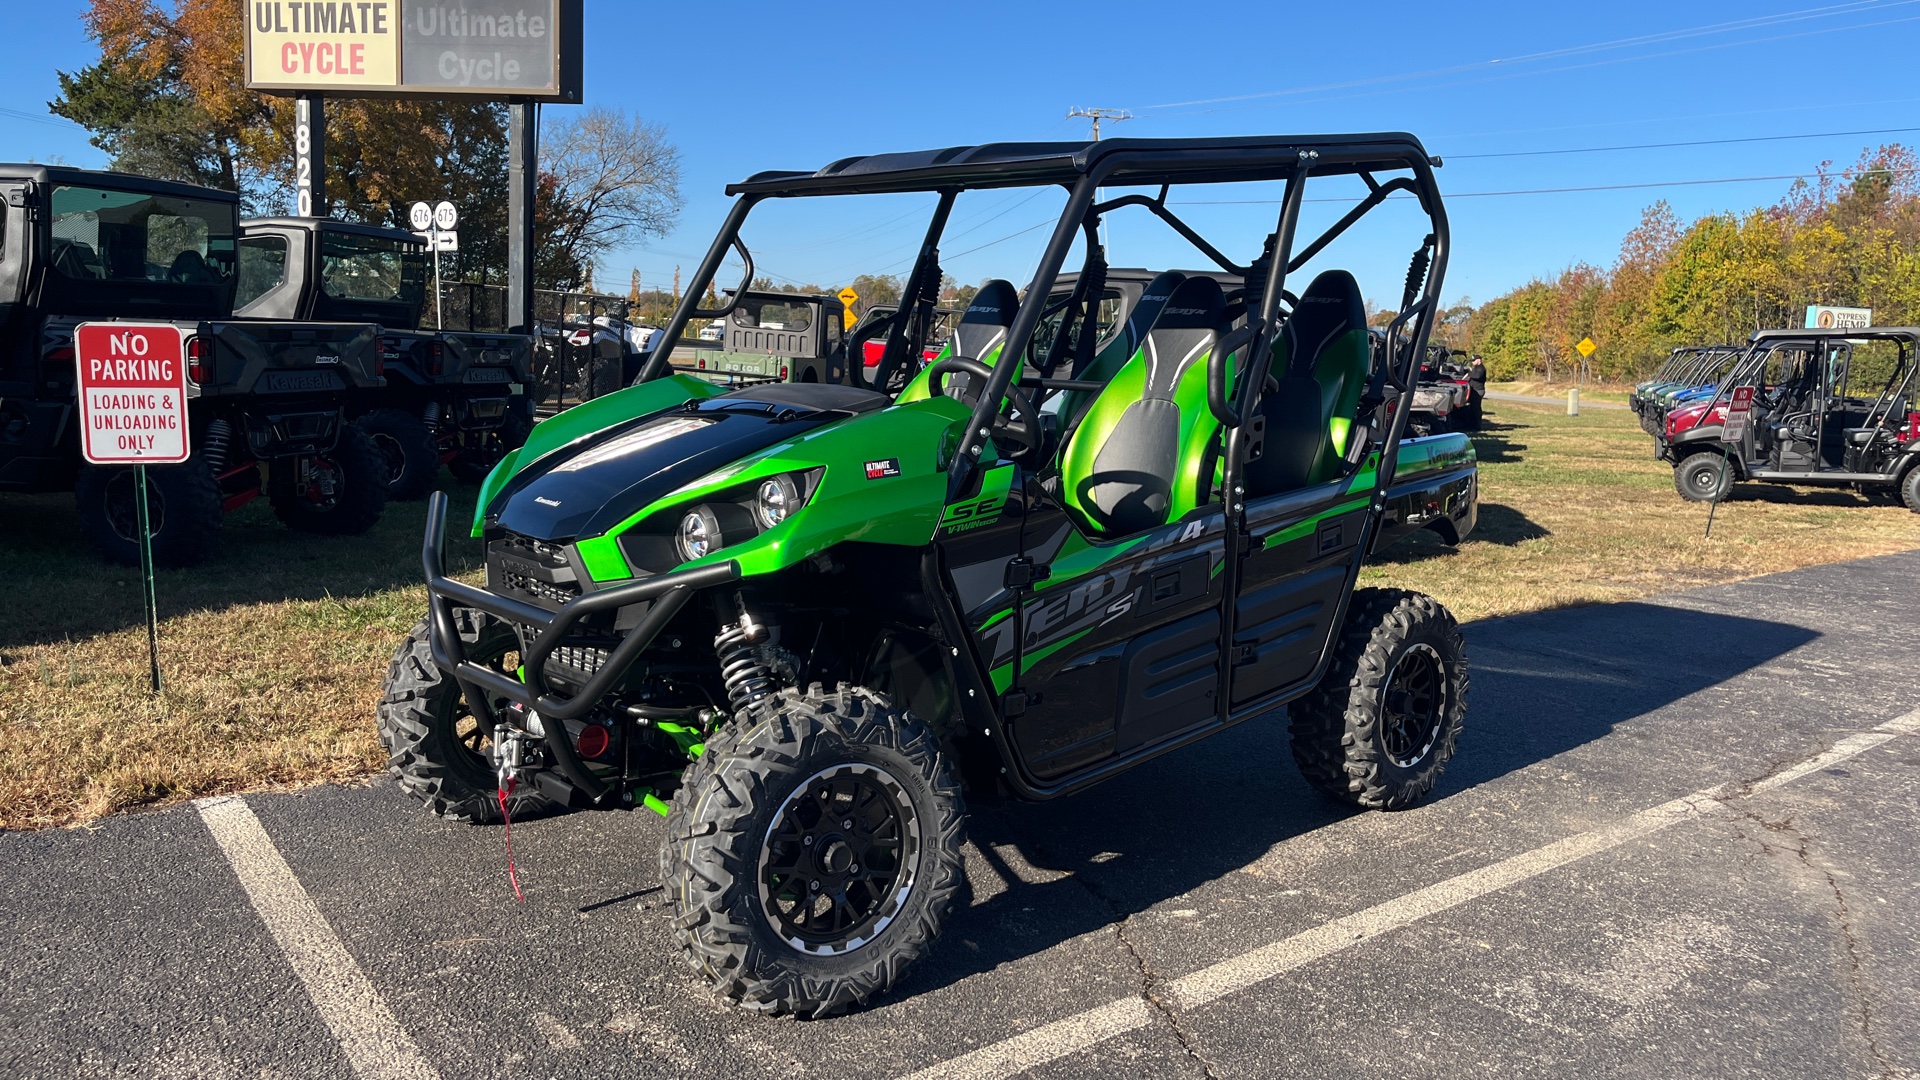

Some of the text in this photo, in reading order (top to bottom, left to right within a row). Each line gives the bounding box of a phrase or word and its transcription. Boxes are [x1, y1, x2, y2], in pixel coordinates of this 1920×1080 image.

[256, 1, 388, 34] ULTIMATE
[416, 7, 545, 38] Ultimate
[281, 41, 365, 75] CYCLE
[438, 50, 521, 85] Cycle
[296, 96, 312, 217] 1820
[413, 209, 429, 223] 676
[437, 208, 454, 222] 675
[1837, 313, 1866, 321] CYPRESS
[110, 333, 149, 356] NO
[90, 359, 173, 381] PARKING
[268, 370, 333, 390] Kawasaki
[93, 394, 174, 410] LOADING &
[1739, 390, 1748, 399] NO
[94, 415, 177, 430] UNLOADING
[118, 435, 155, 450] ONLY
[953, 497, 999, 519] SE
